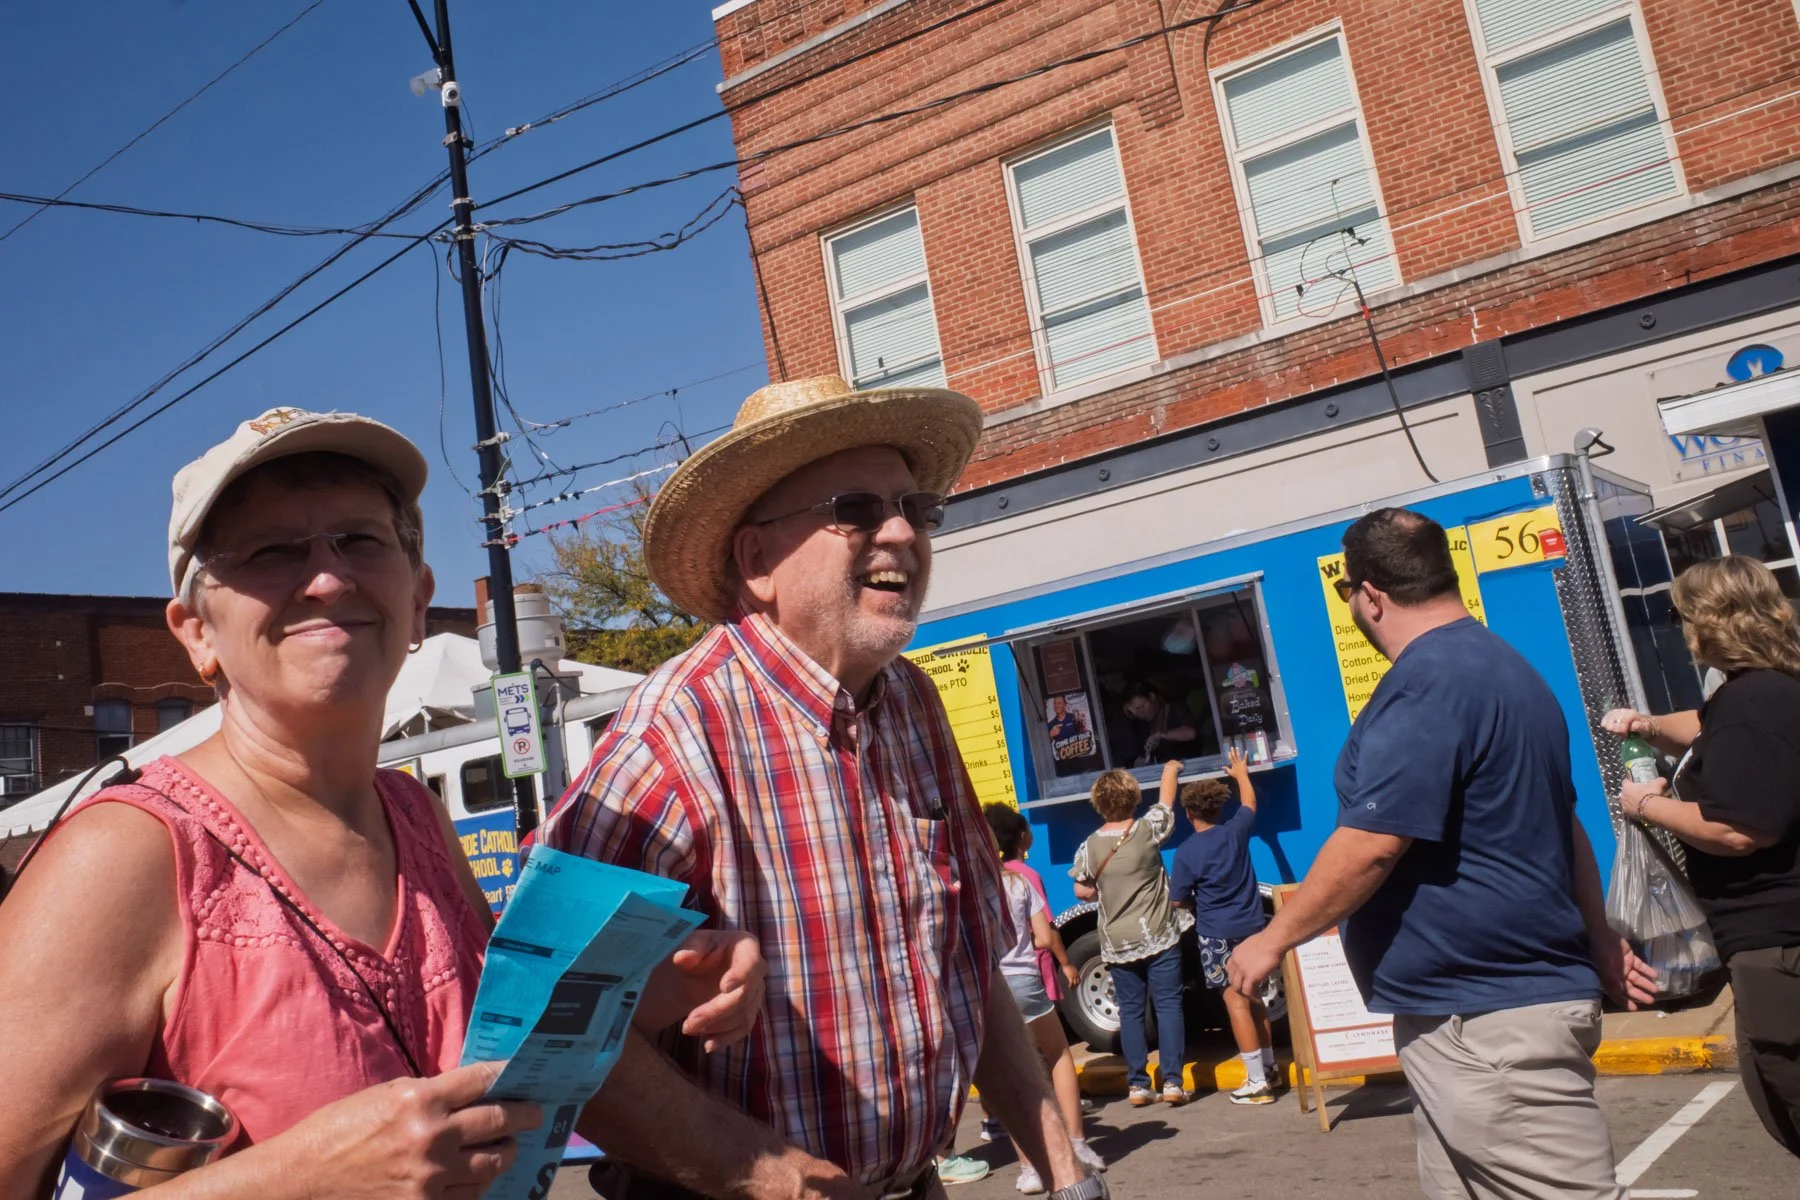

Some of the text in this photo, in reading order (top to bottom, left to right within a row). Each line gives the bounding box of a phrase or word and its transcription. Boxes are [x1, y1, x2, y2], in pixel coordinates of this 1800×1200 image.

[1495, 520, 1539, 560] 56
[1468, 598, 1480, 610] $4
[1335, 624, 1358, 635] Dipp
[1342, 656, 1373, 669] Cotton
[950, 677, 968, 689] PTO
[1345, 673, 1370, 686] Dried
[498, 684, 529, 697] METS
[988, 695, 997, 705] $4
[991, 710, 1000, 720] $5
[994, 725, 1002, 734] $4
[518, 741, 526, 752] P
[997, 740, 1006, 749] $5
[1060, 739, 1090, 760] COFFEE
[1000, 754, 1009, 764] $5
[1003, 769, 1011, 779] $3
[1006, 785, 1014, 794] $4
[535, 860, 562, 876] MAP
[482, 887, 503, 904] eart
